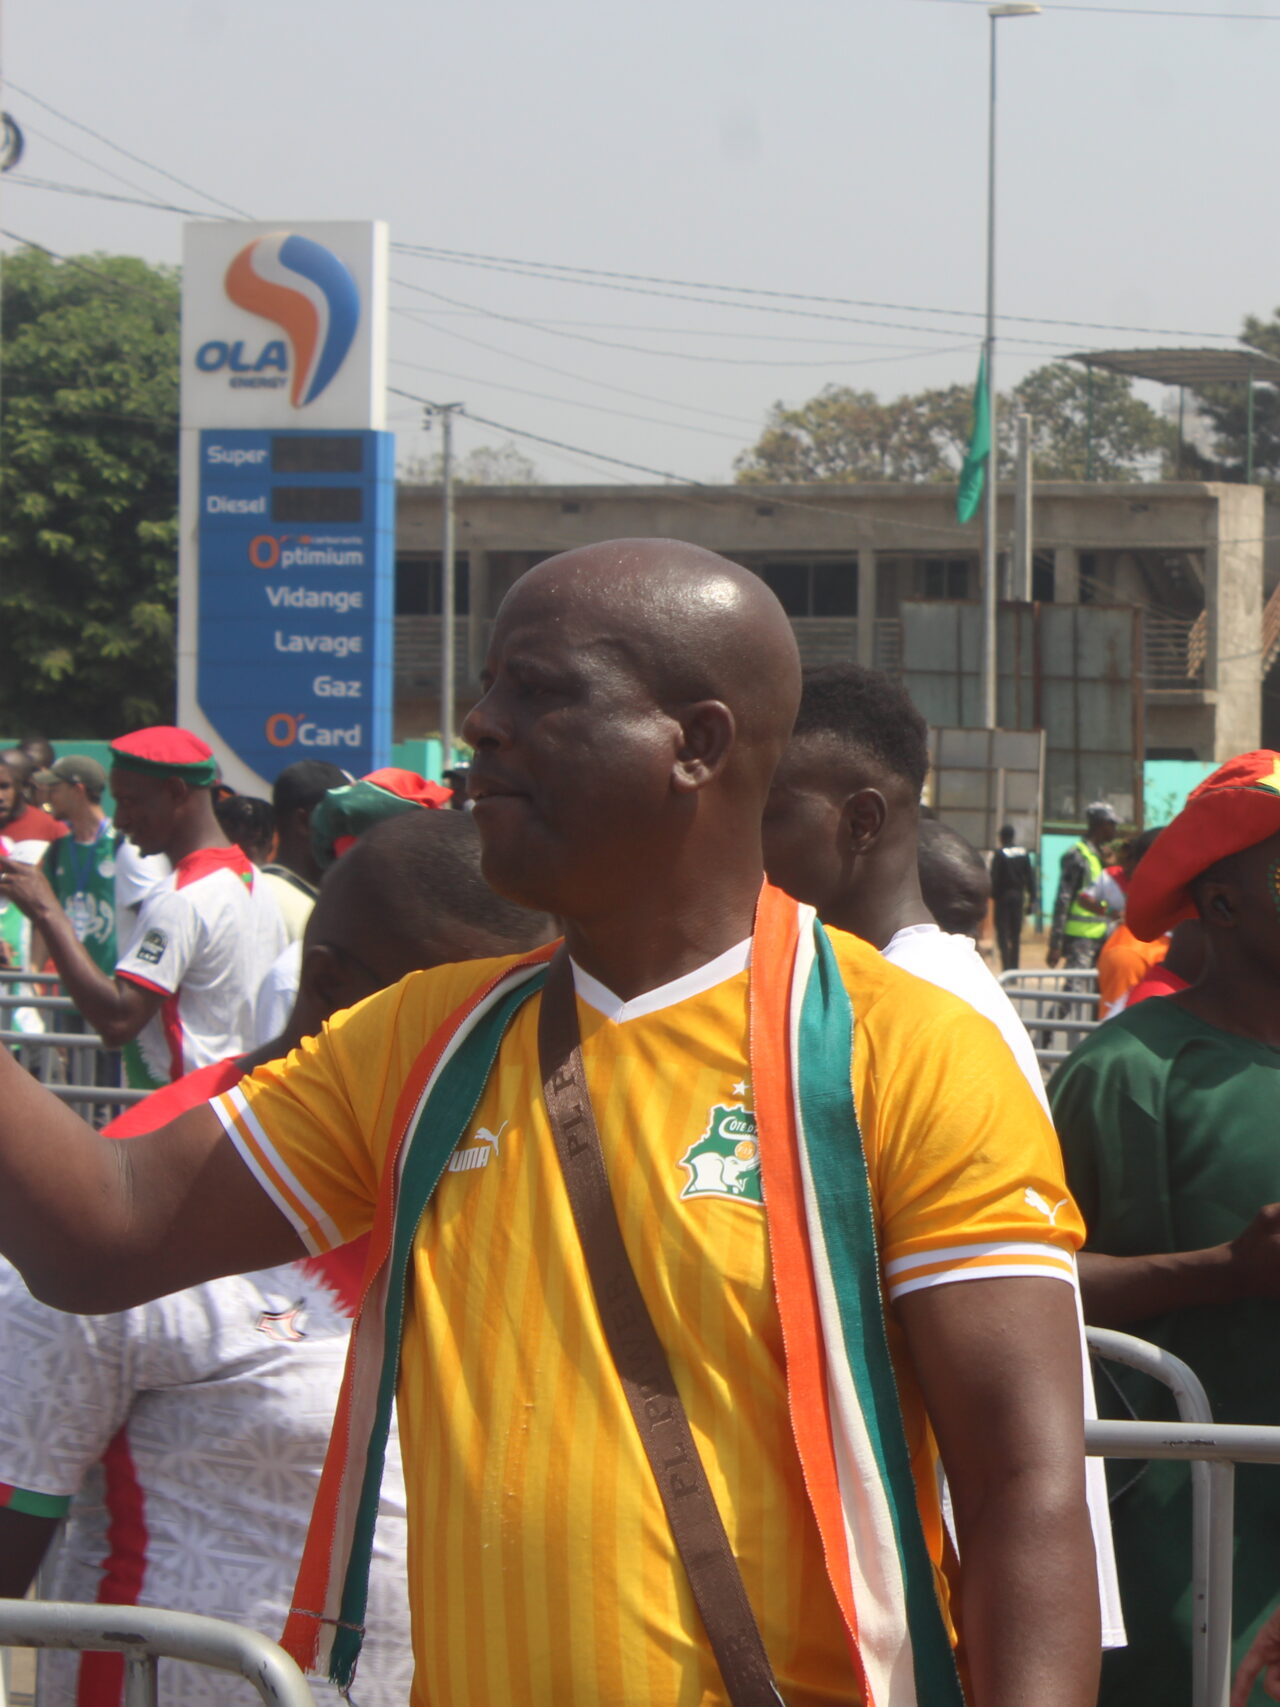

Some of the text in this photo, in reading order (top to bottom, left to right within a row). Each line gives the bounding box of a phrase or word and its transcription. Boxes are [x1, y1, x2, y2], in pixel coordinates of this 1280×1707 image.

[194, 340, 288, 372] OLA
[206, 446, 268, 467] Super
[206, 495, 265, 514] Diesel
[265, 586, 364, 613] Vidange
[275, 631, 363, 657] Lavage
[313, 676, 362, 697] Gaz
[448, 1146, 491, 1172] UMA
